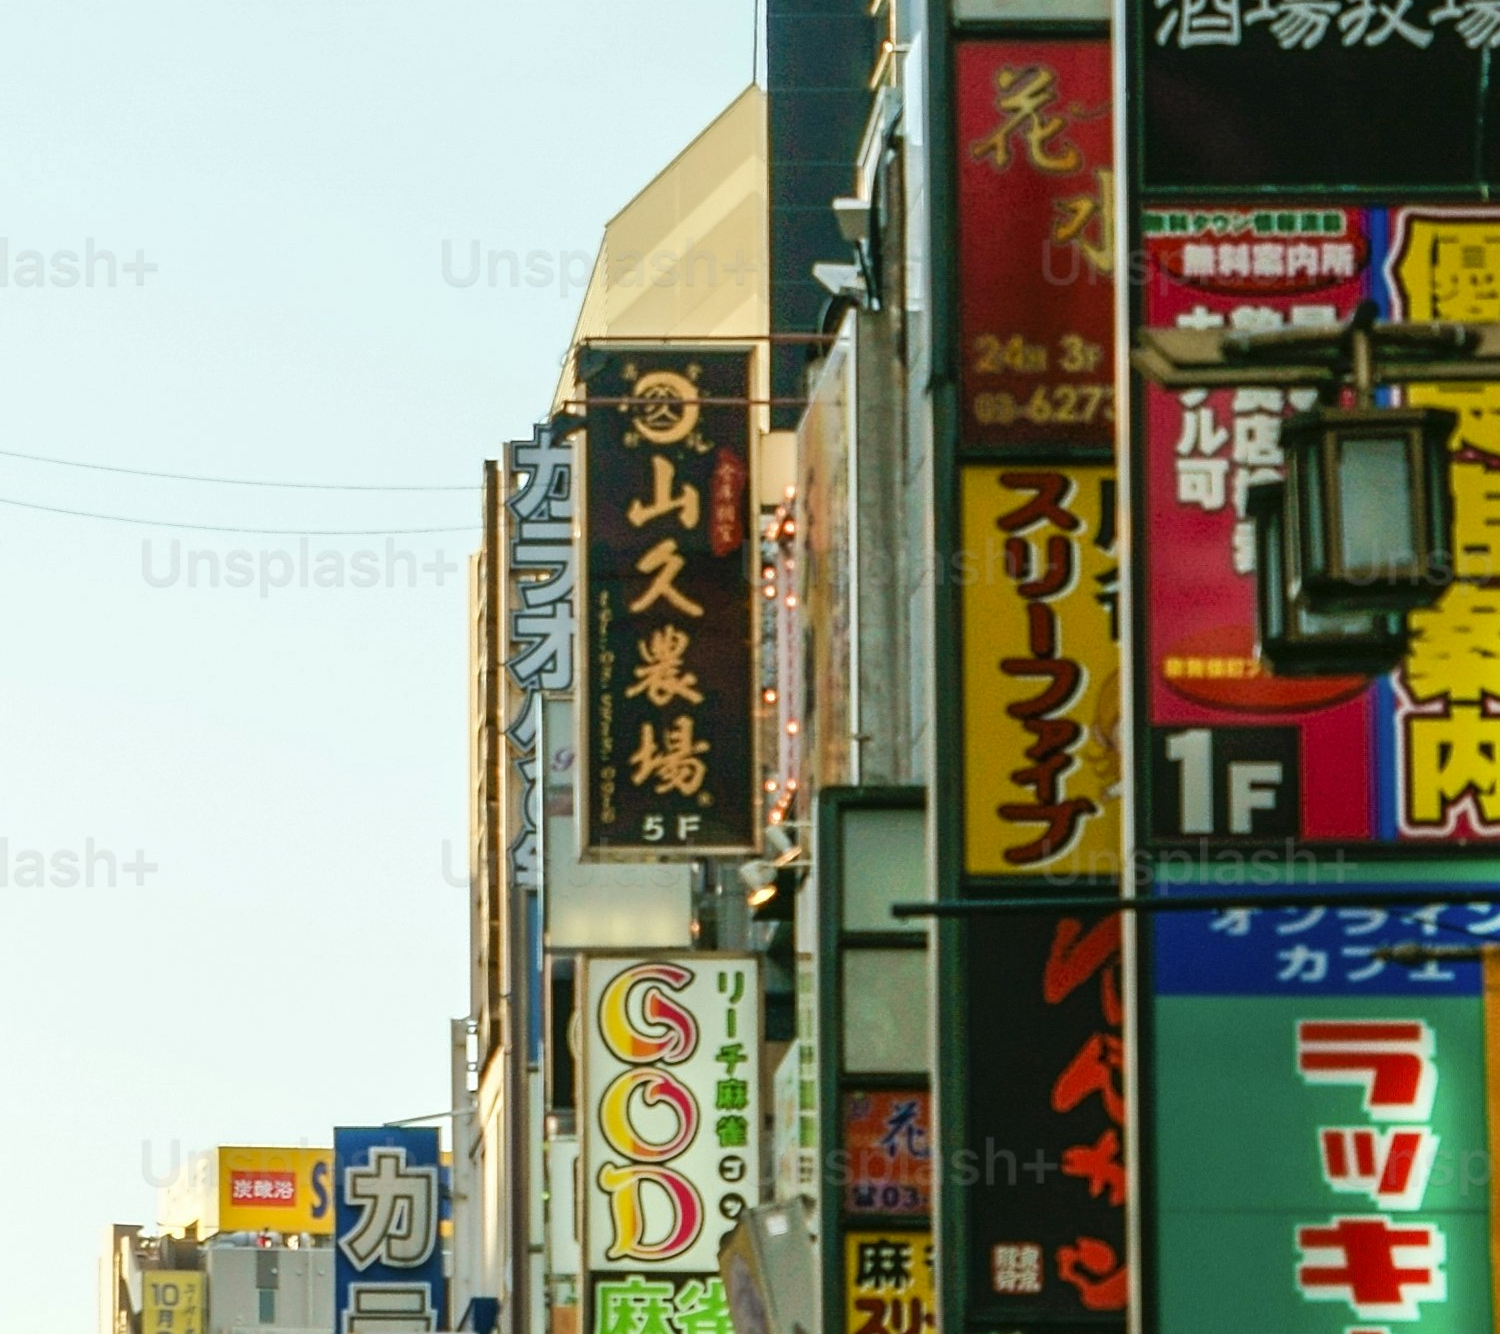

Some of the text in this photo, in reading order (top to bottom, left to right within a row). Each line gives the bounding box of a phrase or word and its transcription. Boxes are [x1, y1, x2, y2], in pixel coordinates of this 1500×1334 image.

[623, 454, 708, 797] 山久農場
[997, 472, 1098, 867] スリーファイブ
[641, 814, 701, 840] 5F
[1166, 729, 1284, 835] 1F
[231, 1177, 295, 1204] 炭酸浴
[598, 961, 705, 1263] GOD
